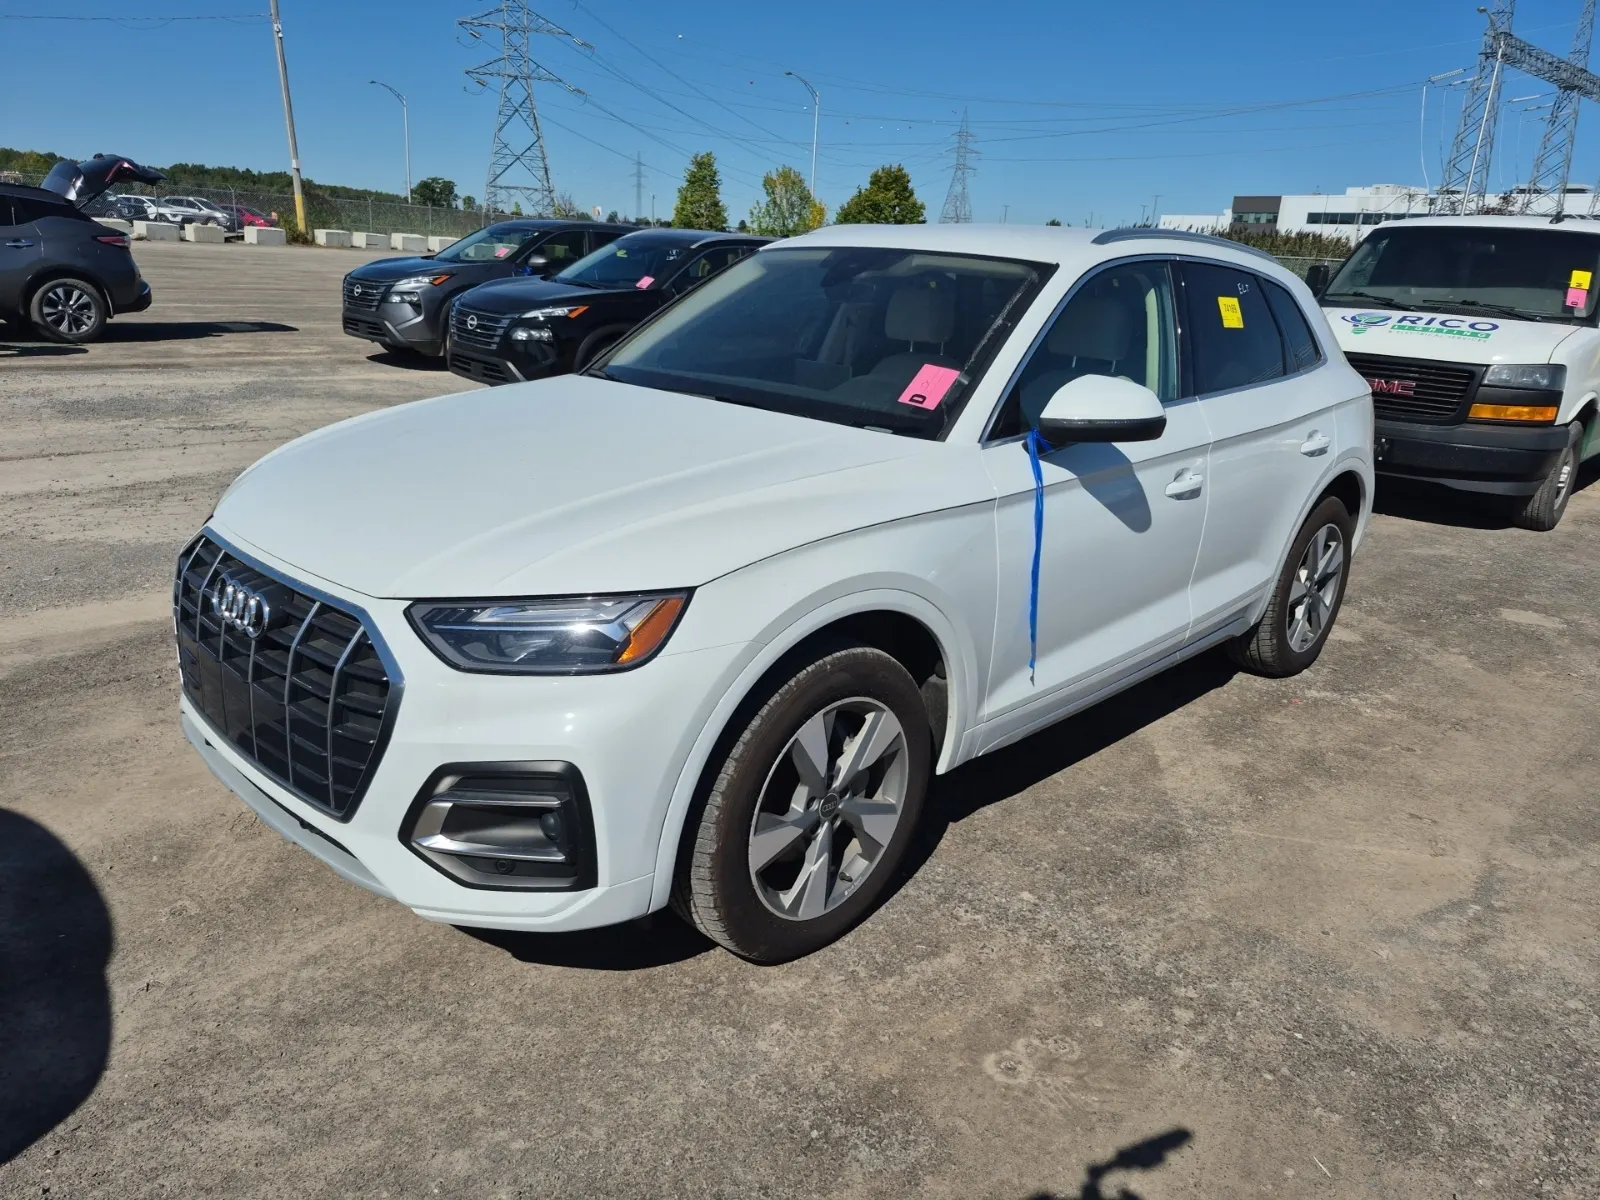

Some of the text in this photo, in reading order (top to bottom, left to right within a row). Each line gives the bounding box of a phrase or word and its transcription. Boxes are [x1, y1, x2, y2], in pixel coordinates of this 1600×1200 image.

[1397, 315, 1500, 332] RICO
[1393, 324, 1489, 338] LIGHTING
[908, 393, 927, 405] D
